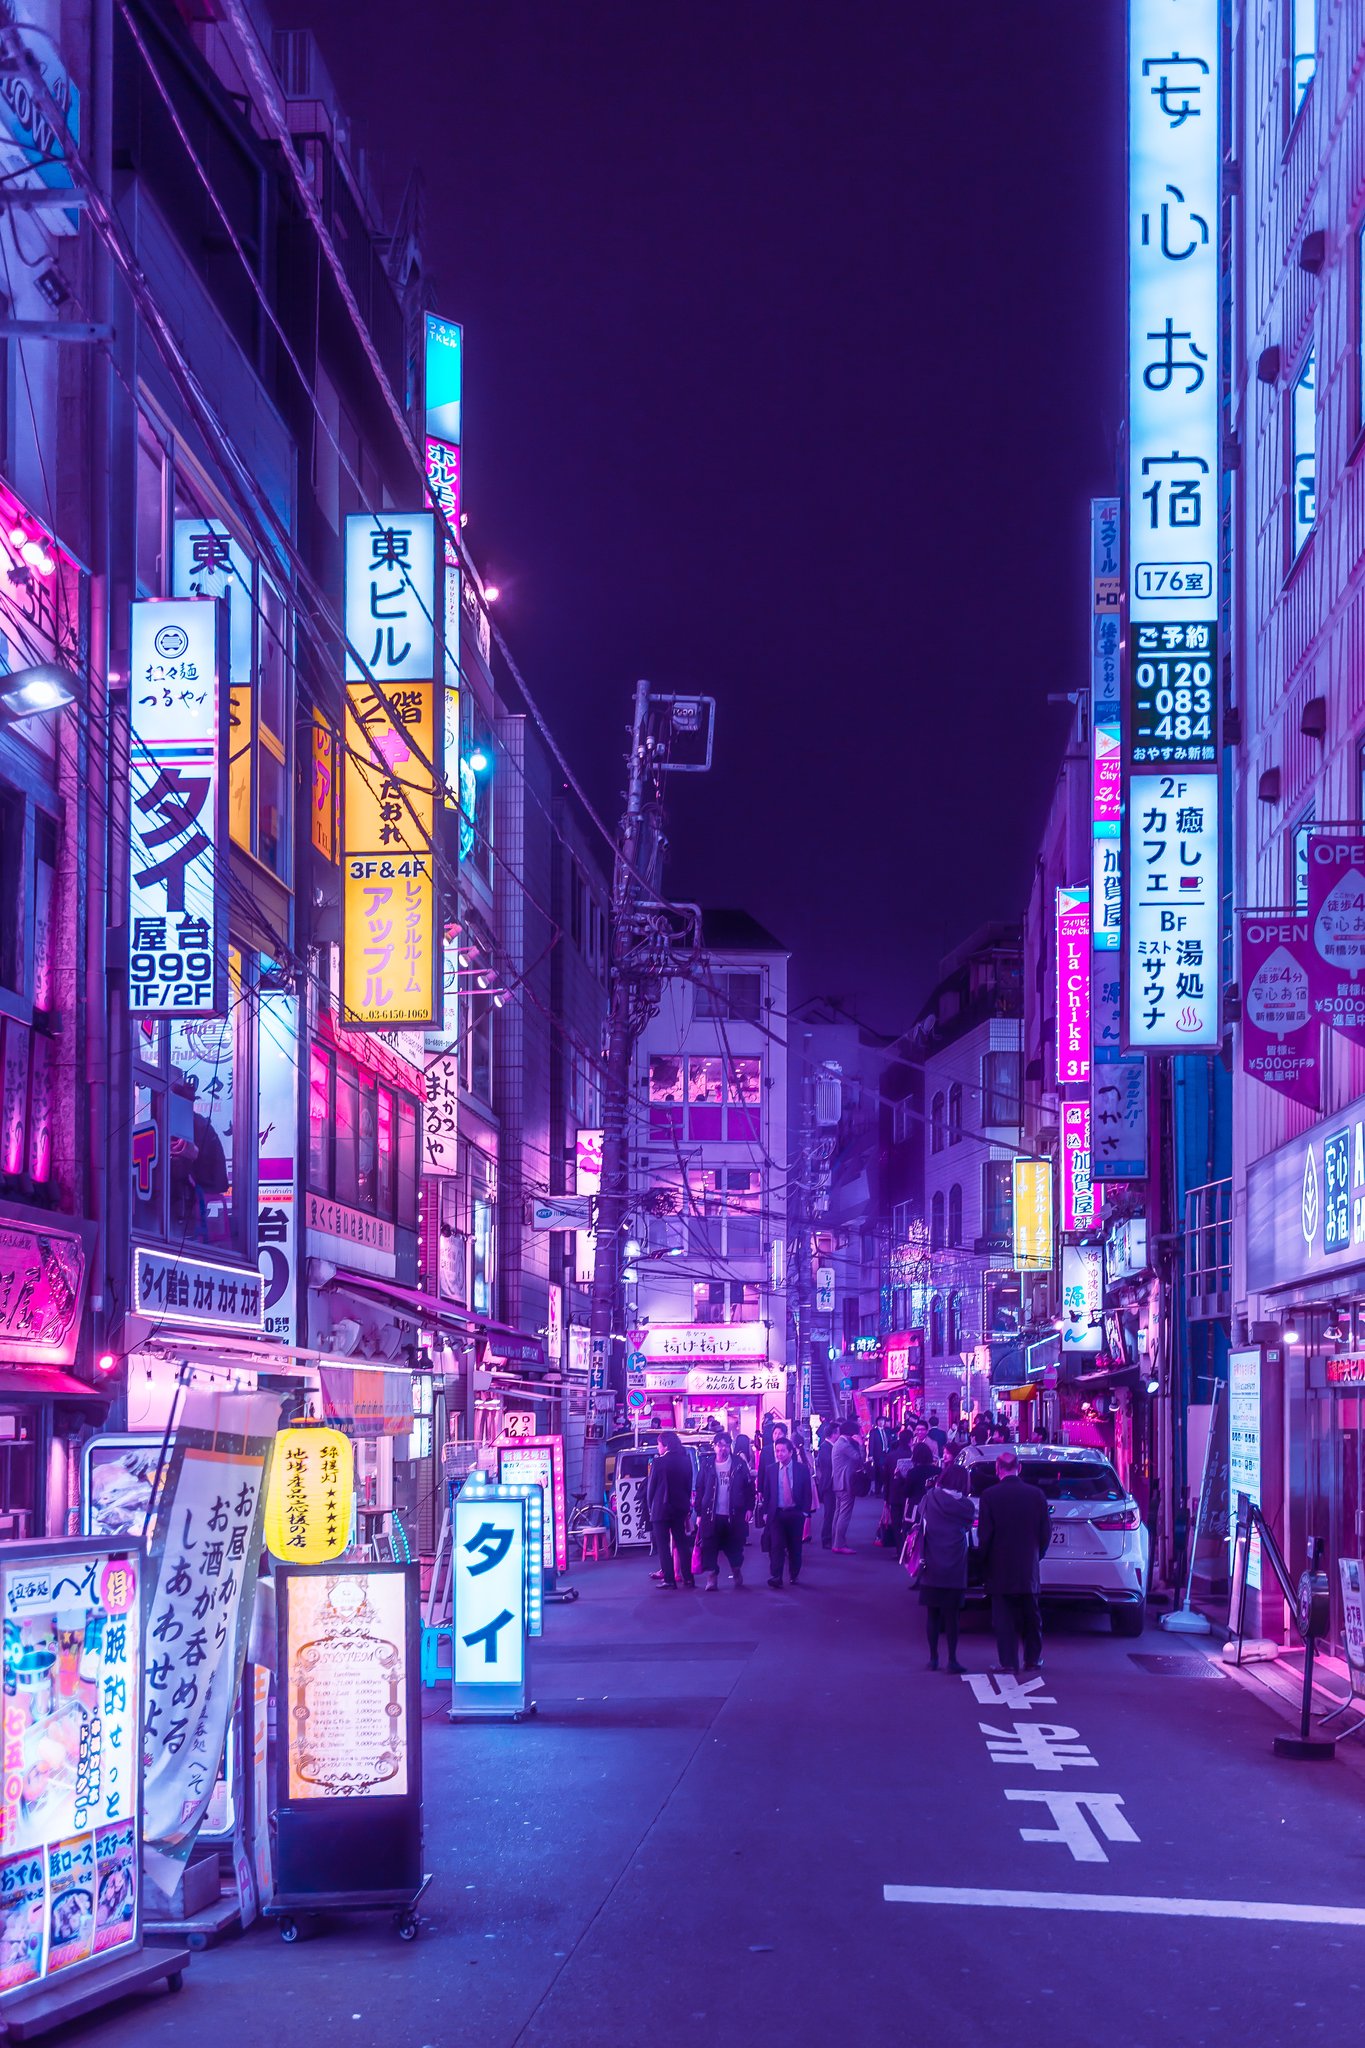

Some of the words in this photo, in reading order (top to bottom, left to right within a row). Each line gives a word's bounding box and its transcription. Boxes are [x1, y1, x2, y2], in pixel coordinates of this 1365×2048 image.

[1141, 51, 1210, 530] 安心お宿
[1100, 507, 1118, 521] 4F
[1100, 520, 1118, 574] スクール
[368, 526, 413, 667] 東ビル
[1142, 570, 1204, 592] 176室
[1138, 624, 1209, 649] ご予約
[145, 661, 199, 683] 担々麺
[1135, 662, 1212, 688] 0120
[1137, 689, 1212, 714] -083
[1137, 715, 1212, 741] -484
[1133, 746, 1215, 761] おやすみ新橋
[1159, 777, 1188, 799] 2F
[131, 767, 212, 913] タイ
[1142, 807, 1169, 892] カフェ
[1175, 806, 1204, 867] 癒し
[350, 861, 427, 880] 3F&4F
[131, 914, 212, 952] 屋台
[404, 880, 422, 993] レンタルルーム
[1160, 911, 1188, 932] BF
[1246, 924, 1309, 944] OPEN
[361, 886, 395, 1008] アップル
[1137, 940, 1172, 955] ミスト
[131, 952, 212, 983] 999
[1175, 938, 1204, 1000] 湯処
[1258, 966, 1303, 985] 徒歩4分
[131, 983, 212, 1007] 1F/2F
[1142, 957, 1166, 1031] サウナ
[1252, 986, 1308, 1001] 安心お宿
[1255, 1011, 1306, 1022] 新橋汐留店
[1266, 1045, 1296, 1056] 皆様に
[441, 1060, 456, 1132] とんかつ
[425, 1071, 445, 1166] まるや
[142, 1262, 190, 1308] タイ屋台
[738, 1375, 780, 1390] しお福
[285, 1447, 310, 1548] 地場産品応援の店
[215, 1481, 255, 1651] お昼から
[462, 1521, 515, 1664] タイ
[162, 1495, 231, 1755] お酒が呑める
[103, 1622, 128, 1819] 晩酌せっと
